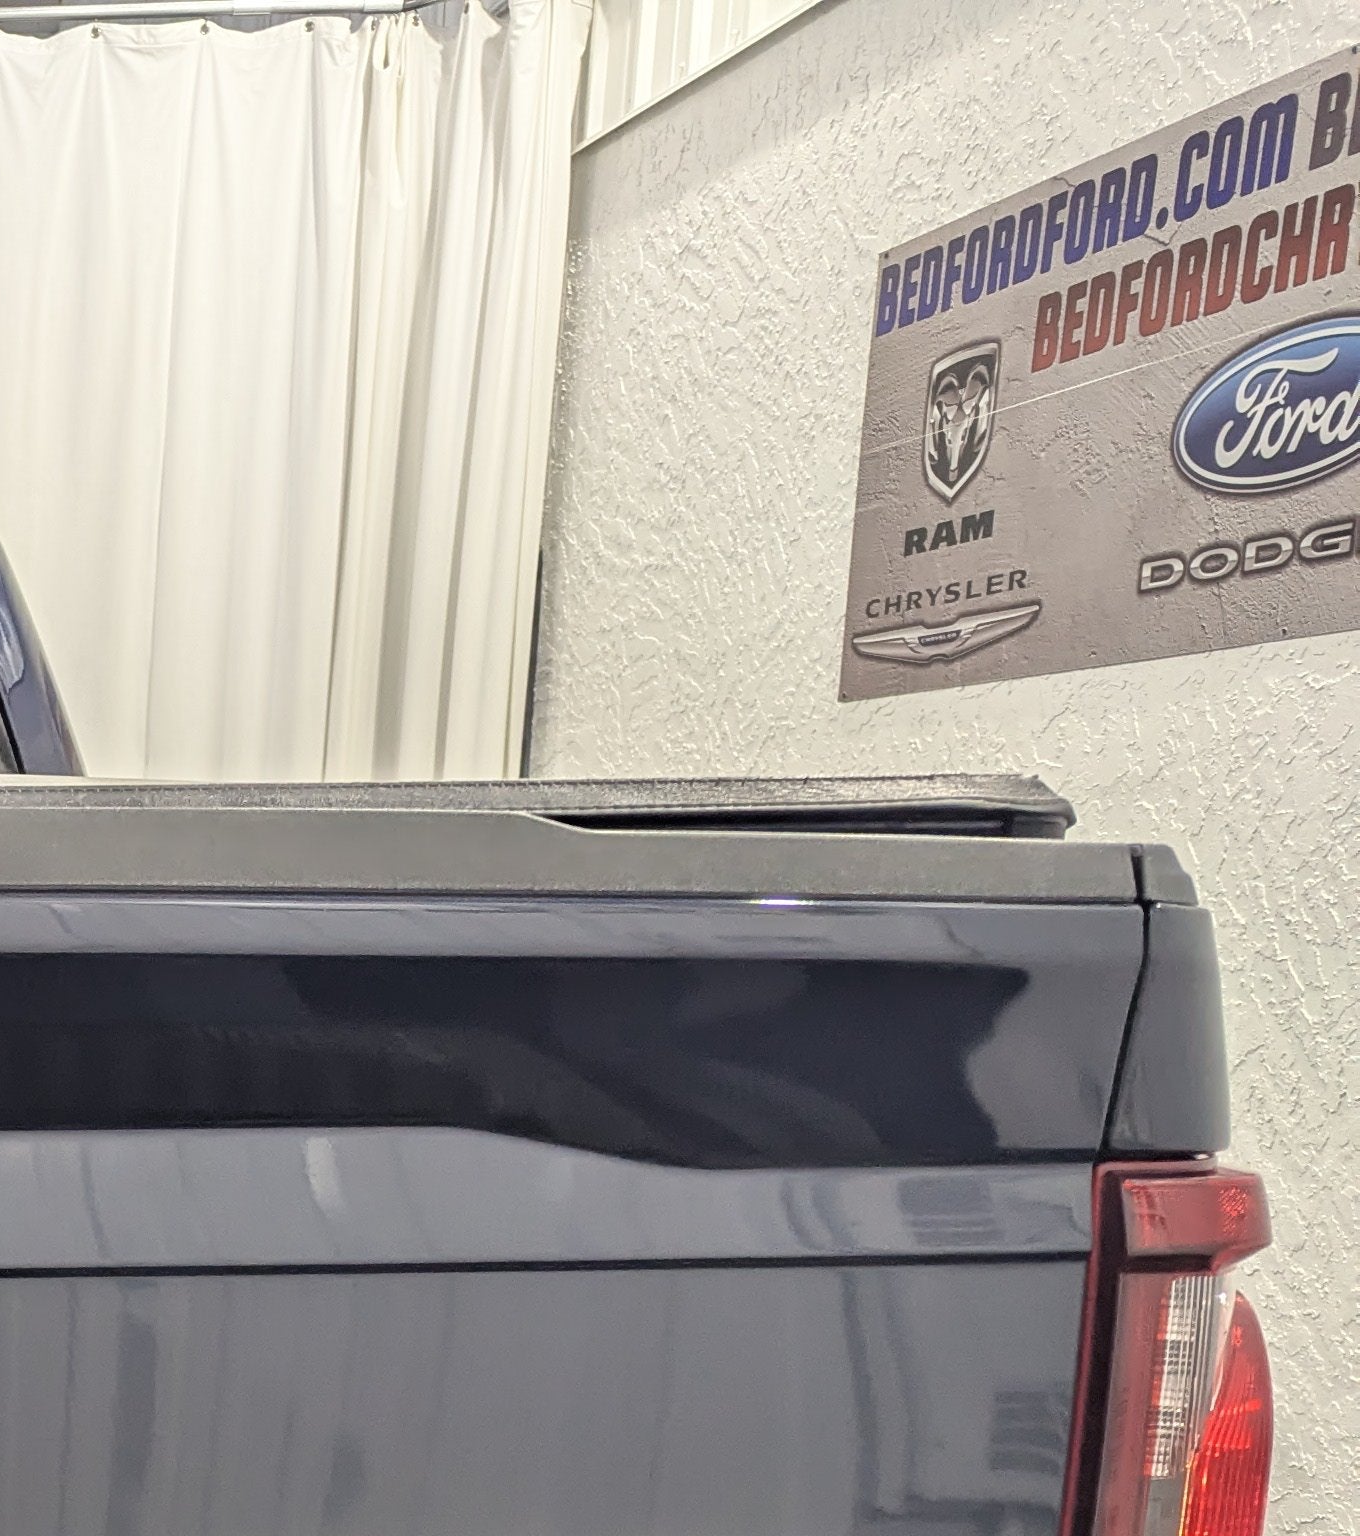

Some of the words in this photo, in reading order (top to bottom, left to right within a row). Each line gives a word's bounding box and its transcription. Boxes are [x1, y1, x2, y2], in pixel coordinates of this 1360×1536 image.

[874, 93, 1300, 339] BEDFORDFORD.COM
[1031, 183, 1360, 373] BEDFORDCHR
[903, 509, 995, 558] RAM
[1139, 521, 1360, 592] DODG
[865, 569, 1028, 618] CHRYSLER
